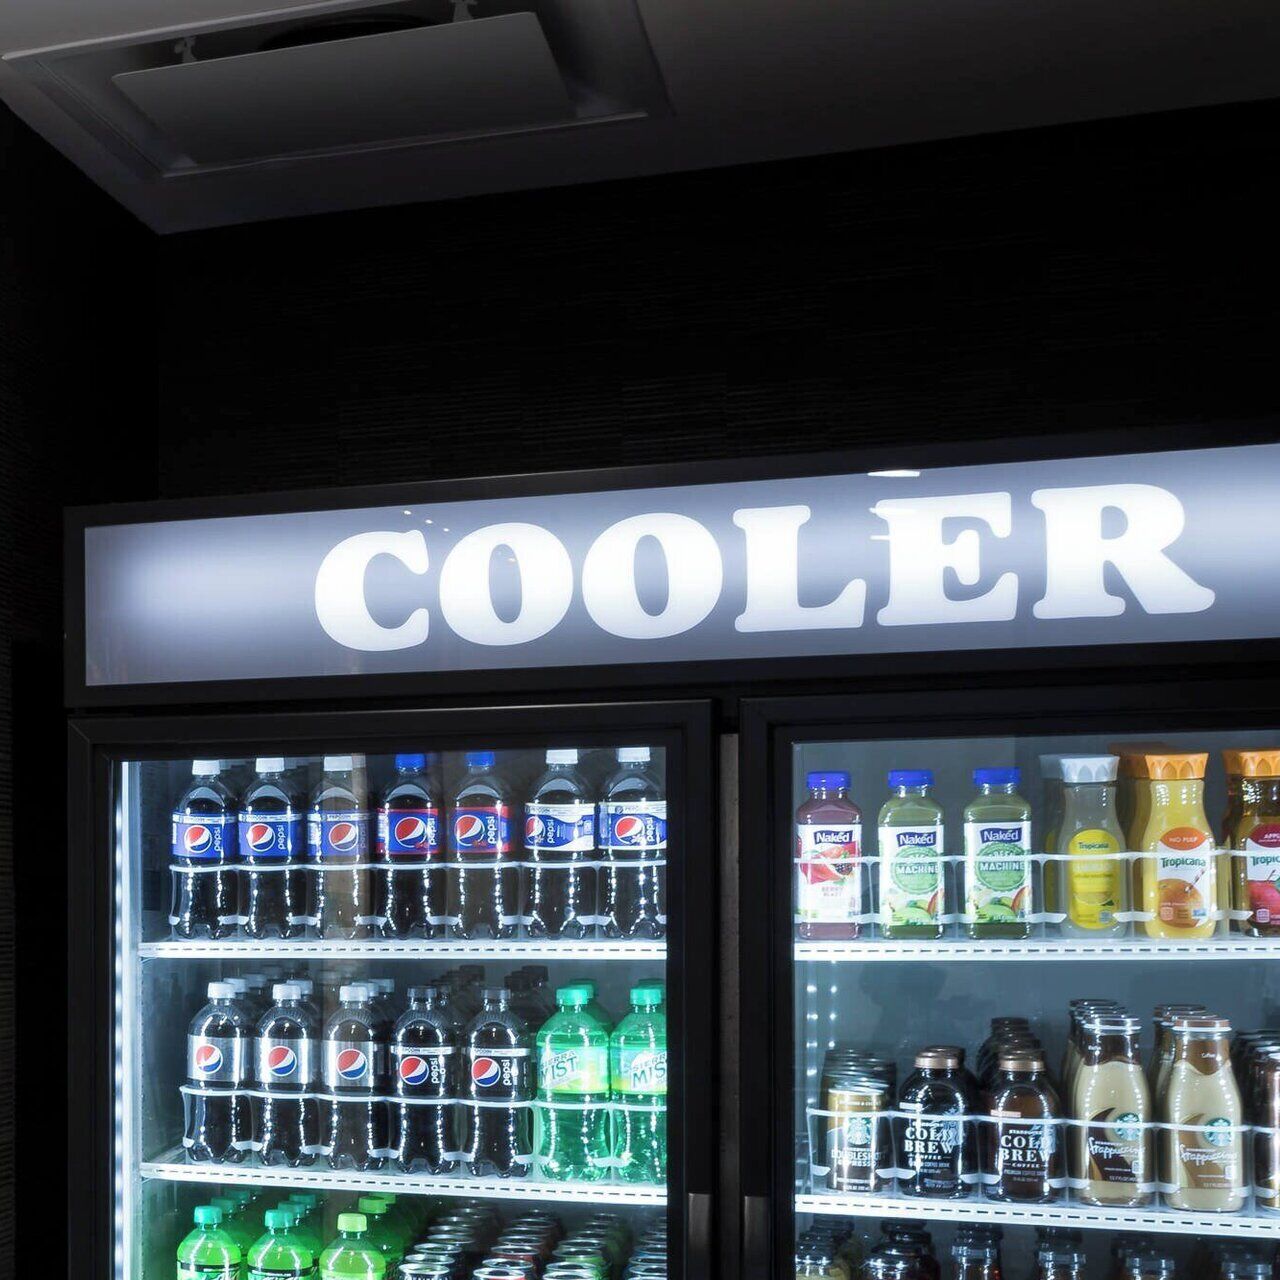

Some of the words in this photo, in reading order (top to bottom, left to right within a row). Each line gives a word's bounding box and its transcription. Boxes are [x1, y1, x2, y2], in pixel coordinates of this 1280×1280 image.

[313, 482, 1217, 653] COOLER
[213, 826, 223, 853] pepsi
[277, 824, 288, 850] pepsi
[428, 817, 438, 846] pepsi
[486, 815, 496, 845] pepsi
[546, 819, 557, 844] pepsi
[645, 816, 655, 843] pepsi
[979, 861, 1026, 872] MACHINE
[1160, 856, 1207, 869] Tropicana
[502, 1059, 513, 1087] pepsi
[903, 1139, 955, 1155] BREW
